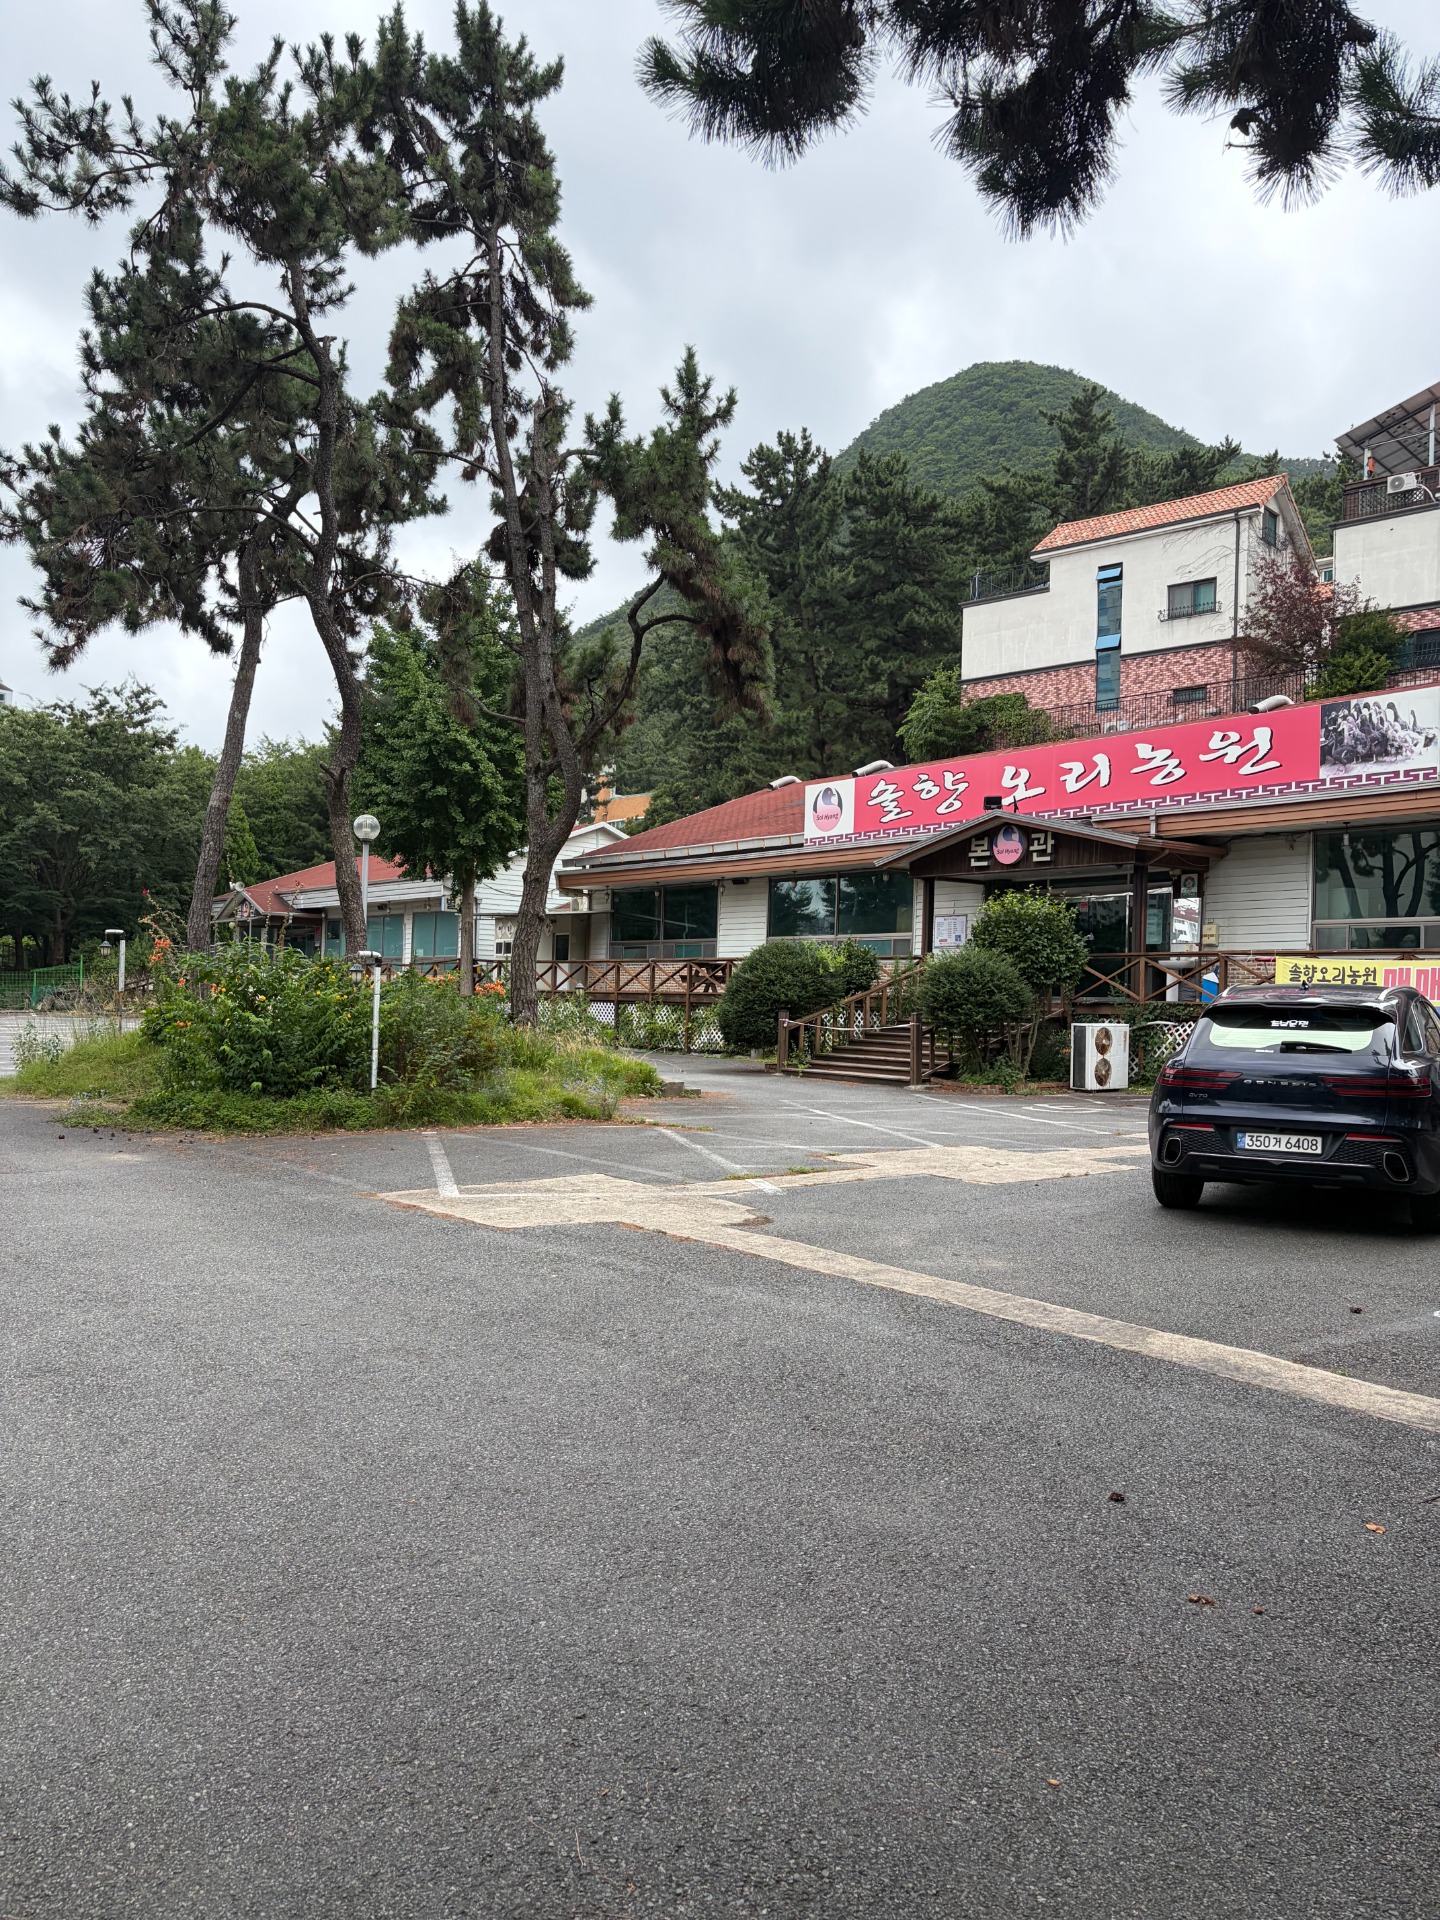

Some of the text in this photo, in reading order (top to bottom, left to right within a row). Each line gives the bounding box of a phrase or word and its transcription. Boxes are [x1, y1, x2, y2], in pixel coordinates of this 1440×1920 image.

[867, 726, 1282, 823] 솔향 오리농원
[1288, 962, 1378, 986] 솔향오리농원
[1243, 1079, 1317, 1087] GENESIS
[1246, 1134, 1319, 1151] 350거 6408
